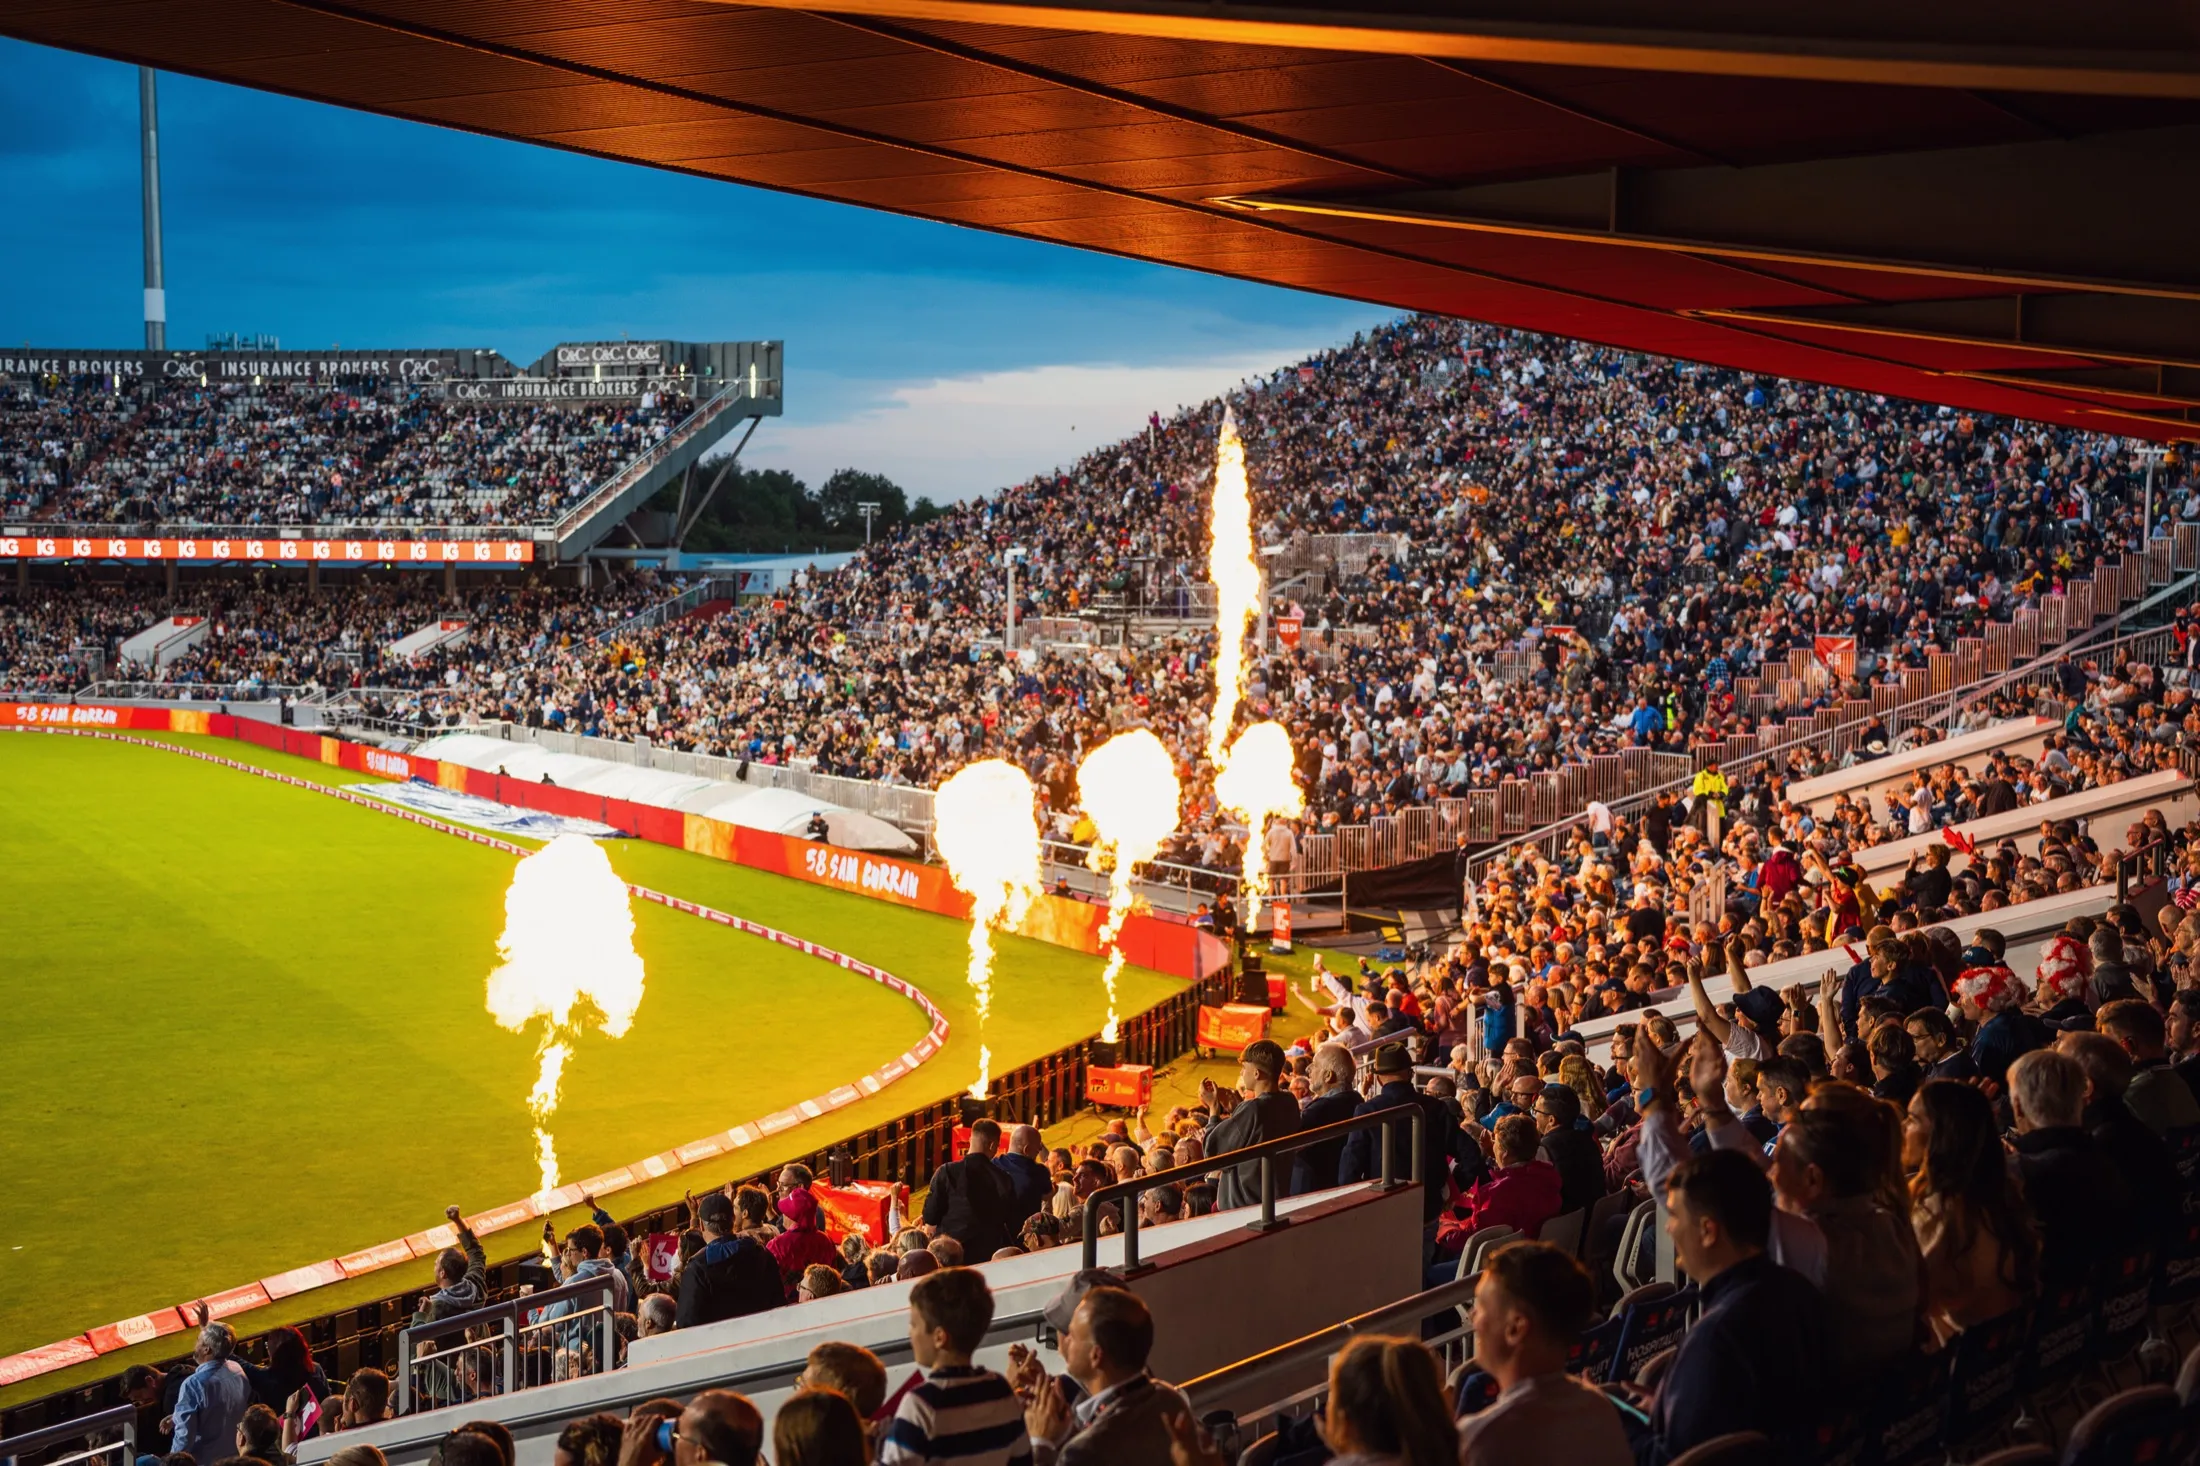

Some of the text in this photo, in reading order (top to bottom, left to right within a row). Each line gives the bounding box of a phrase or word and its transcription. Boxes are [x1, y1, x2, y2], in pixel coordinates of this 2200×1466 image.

[0, 359, 60, 374] RANCE
[68, 360, 144, 376] BROKERS
[221, 361, 312, 376] INSURANCE
[502, 383, 575, 397] INSURANCE
[580, 382, 637, 396] BROKERS
[37, 539, 55, 556] IG
[73, 540, 91, 556] IG
[108, 540, 126, 556] IG
[144, 540, 161, 557] IG
[178, 541, 196, 557] IG
[213, 541, 230, 558] IG
[246, 541, 264, 558] IG
[280, 541, 297, 558] IG
[313, 542, 330, 559] IG
[346, 542, 363, 559] IG
[378, 542, 395, 560] IG
[410, 542, 427, 560] IG
[442, 543, 459, 560] IG
[474, 543, 491, 560] IG
[506, 543, 522, 561] IG
[41, 706, 69, 724] SAM
[806, 847, 919, 900] 58 SAM CURRAN
[0, 1360, 37, 1379] ealth
